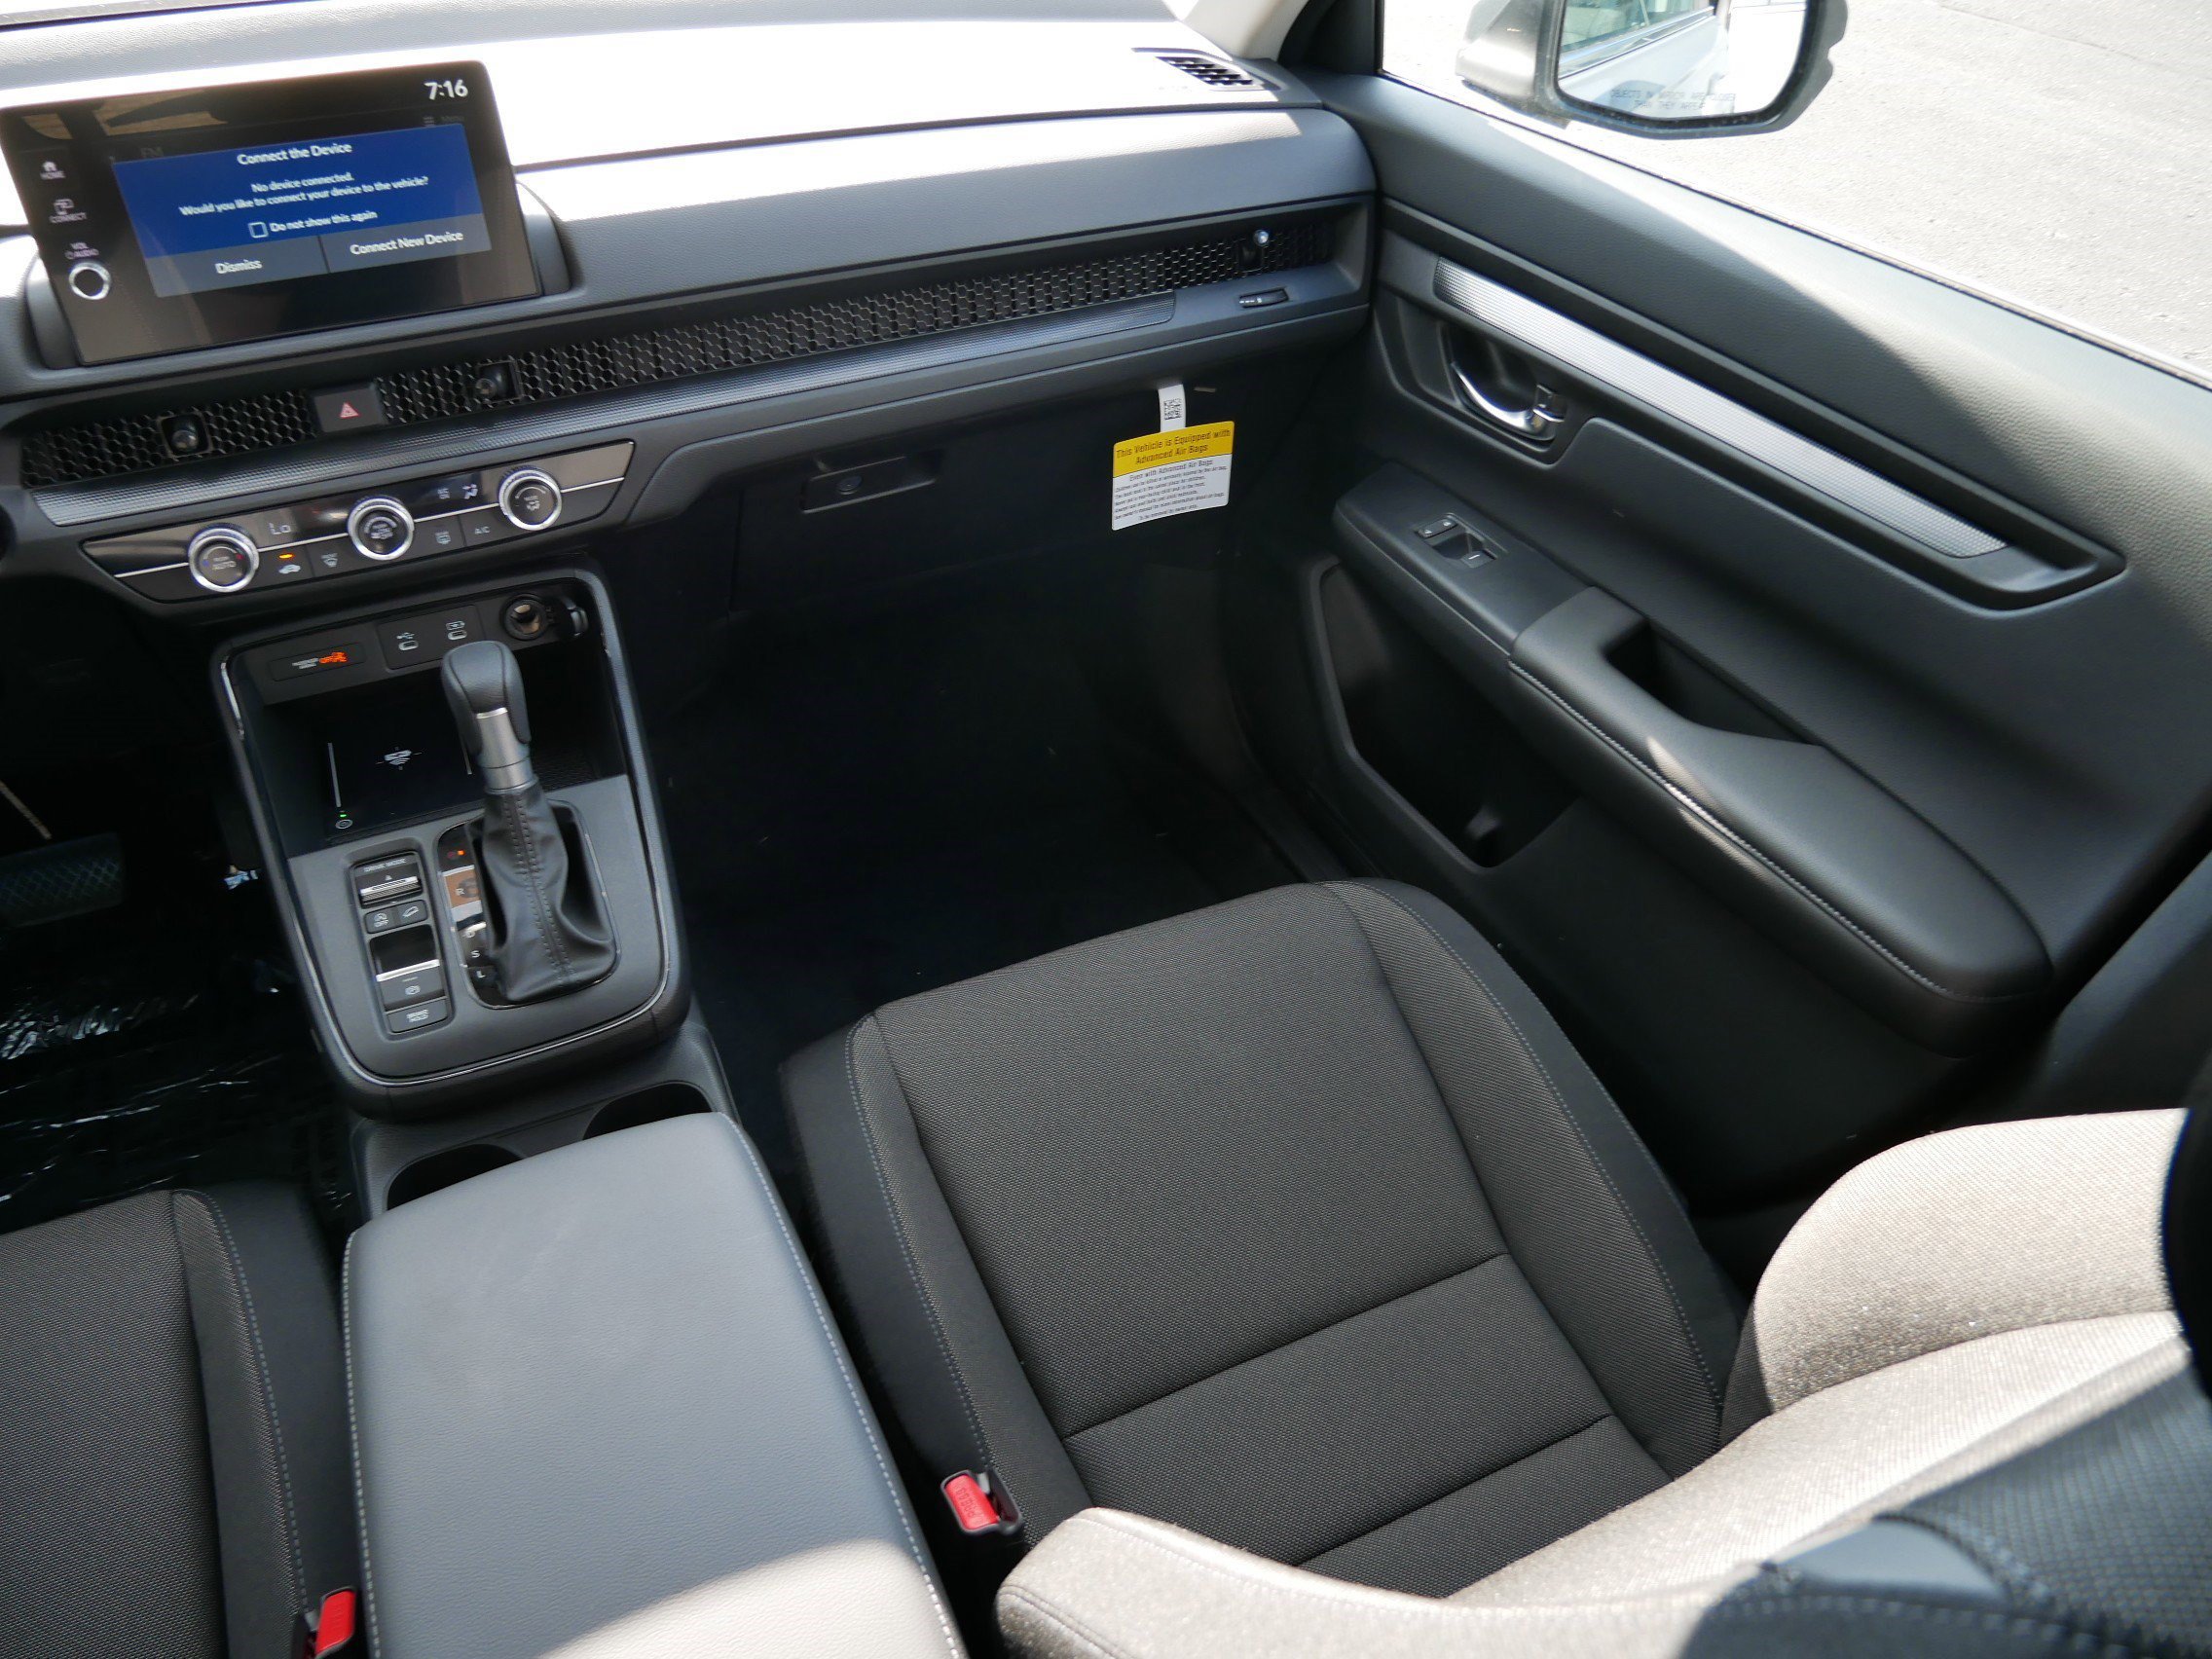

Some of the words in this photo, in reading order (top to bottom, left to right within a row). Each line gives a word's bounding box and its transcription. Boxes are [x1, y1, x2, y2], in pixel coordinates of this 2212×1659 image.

[424, 79, 468, 100] 7:16
[237, 149, 289, 166] Connect
[288, 147, 311, 160] the
[310, 142, 352, 157] Device
[251, 182, 269, 193] No
[269, 178, 302, 191] device
[301, 171, 354, 187] connected.
[178, 202, 215, 216] Would
[214, 203, 236, 213] you
[234, 198, 254, 209] like
[253, 197, 267, 207] to
[266, 191, 308, 205] connect
[306, 190, 330, 202] your
[330, 185, 363, 197] device
[361, 182, 375, 193] to
[373, 180, 391, 192] the
[390, 175, 429, 189] vehicle?
[269, 221, 287, 233] Do
[285, 219, 305, 230] not
[304, 216, 332, 228] show
[330, 213, 351, 225] this
[350, 209, 379, 223] again
[350, 240, 398, 256] Connect
[396, 237, 425, 250] New
[424, 230, 465, 246] Device
[214, 258, 263, 276] Dismiss
[1117, 448, 1131, 459] This
[1134, 441, 1162, 453] Vehicle
[1174, 431, 1212, 445] Equipped
[1135, 450, 1173, 464] Advanced
[1175, 448, 1187, 457] Air
[1188, 443, 1209, 455] Bags
[474, 526, 491, 535] A/C
[470, 949, 481, 958] S
[476, 970, 486, 978] L
